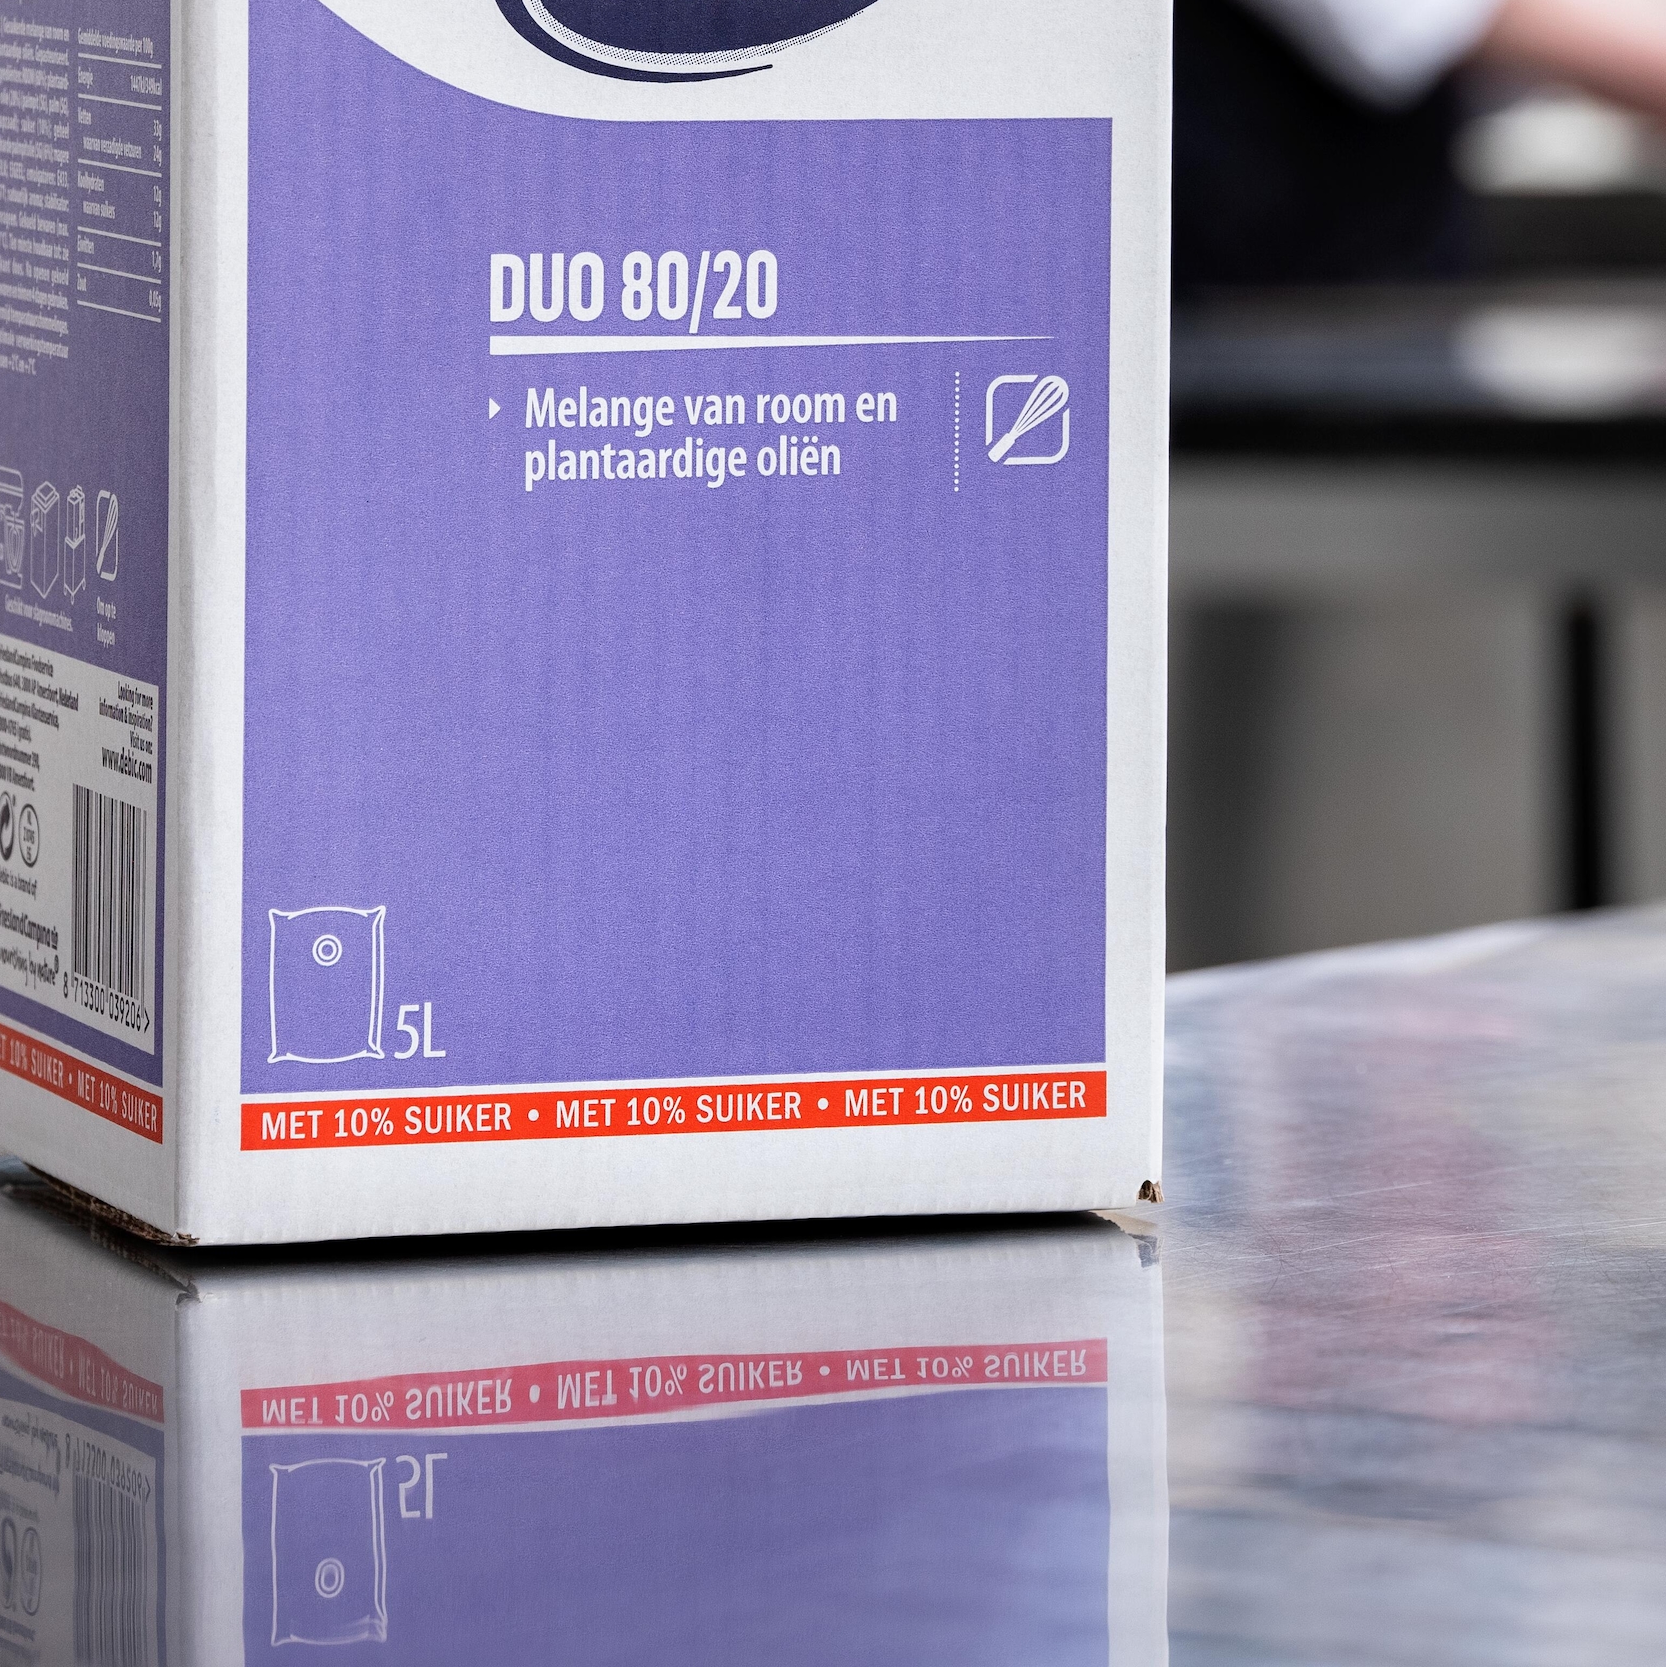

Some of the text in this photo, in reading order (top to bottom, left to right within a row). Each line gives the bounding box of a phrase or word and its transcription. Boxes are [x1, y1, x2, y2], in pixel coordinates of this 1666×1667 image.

[489, 249, 779, 335] DUO 80/20
[524, 385, 899, 439] Melange van room en
[524, 434, 842, 493] plantaardige oliën
[117, 680, 135, 708] Looking
[141, 693, 154, 712] more
[101, 745, 153, 784] www.debic.com
[63, 971, 69, 999] 8
[74, 975, 105, 1016] 713300
[108, 991, 142, 1033] 039206
[393, 1001, 447, 1061] 5L
[9, 1037, 28, 1072] 10%
[30, 1047, 65, 1089] SUIKER
[77, 1068, 96, 1104] MET
[99, 1080, 118, 1115] 10%
[121, 1090, 158, 1133] SUIKER
[261, 1080, 1088, 1142] MET 10% SUIKER MET 10% SUIKER MET 10% SUIKER
